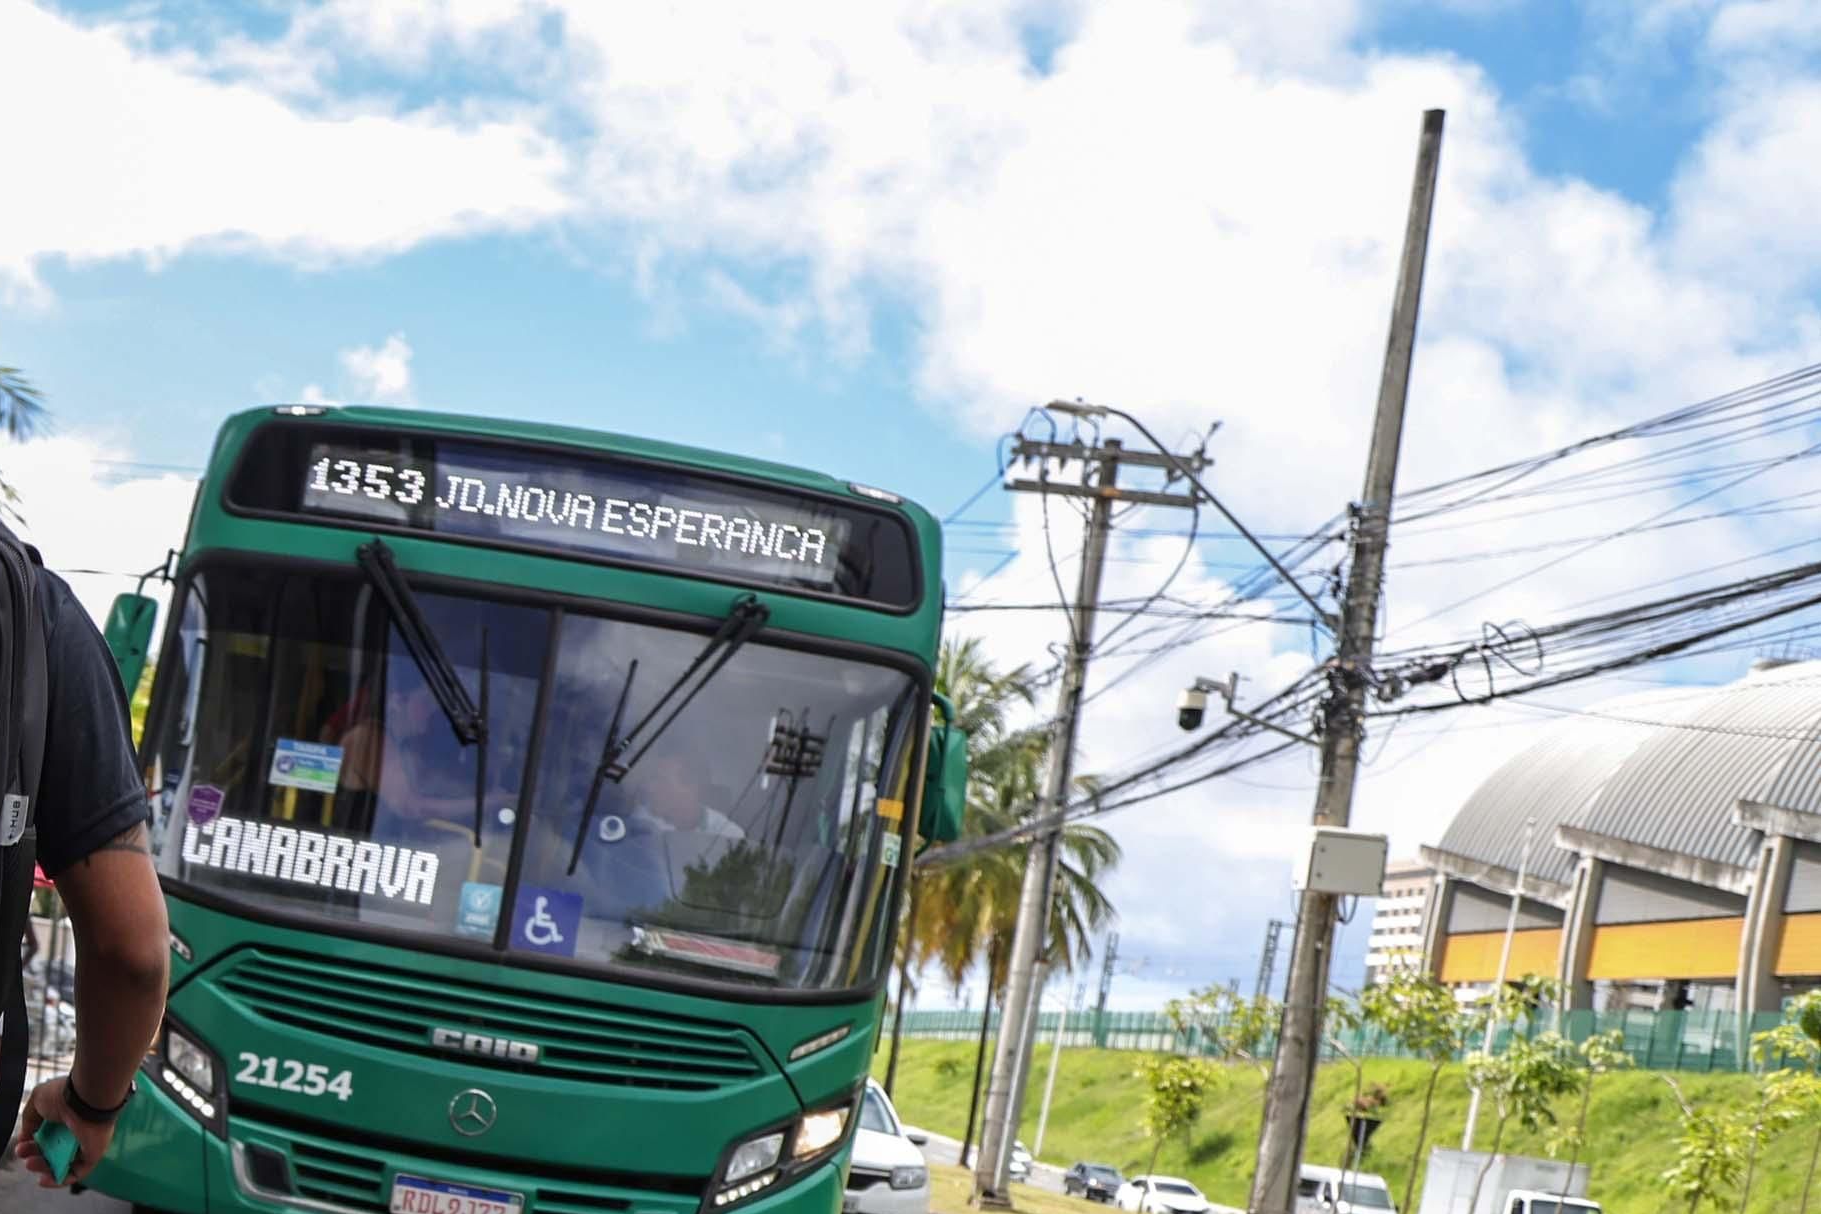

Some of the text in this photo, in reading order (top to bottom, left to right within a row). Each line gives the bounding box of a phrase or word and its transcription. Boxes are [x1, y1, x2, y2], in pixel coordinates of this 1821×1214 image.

[310, 457, 426, 504] 1353
[601, 498, 826, 564] ESPERANCA
[182, 817, 439, 905] CANABRAVA
[235, 1052, 353, 1101] 21254
[433, 1027, 539, 1063] CAIO
